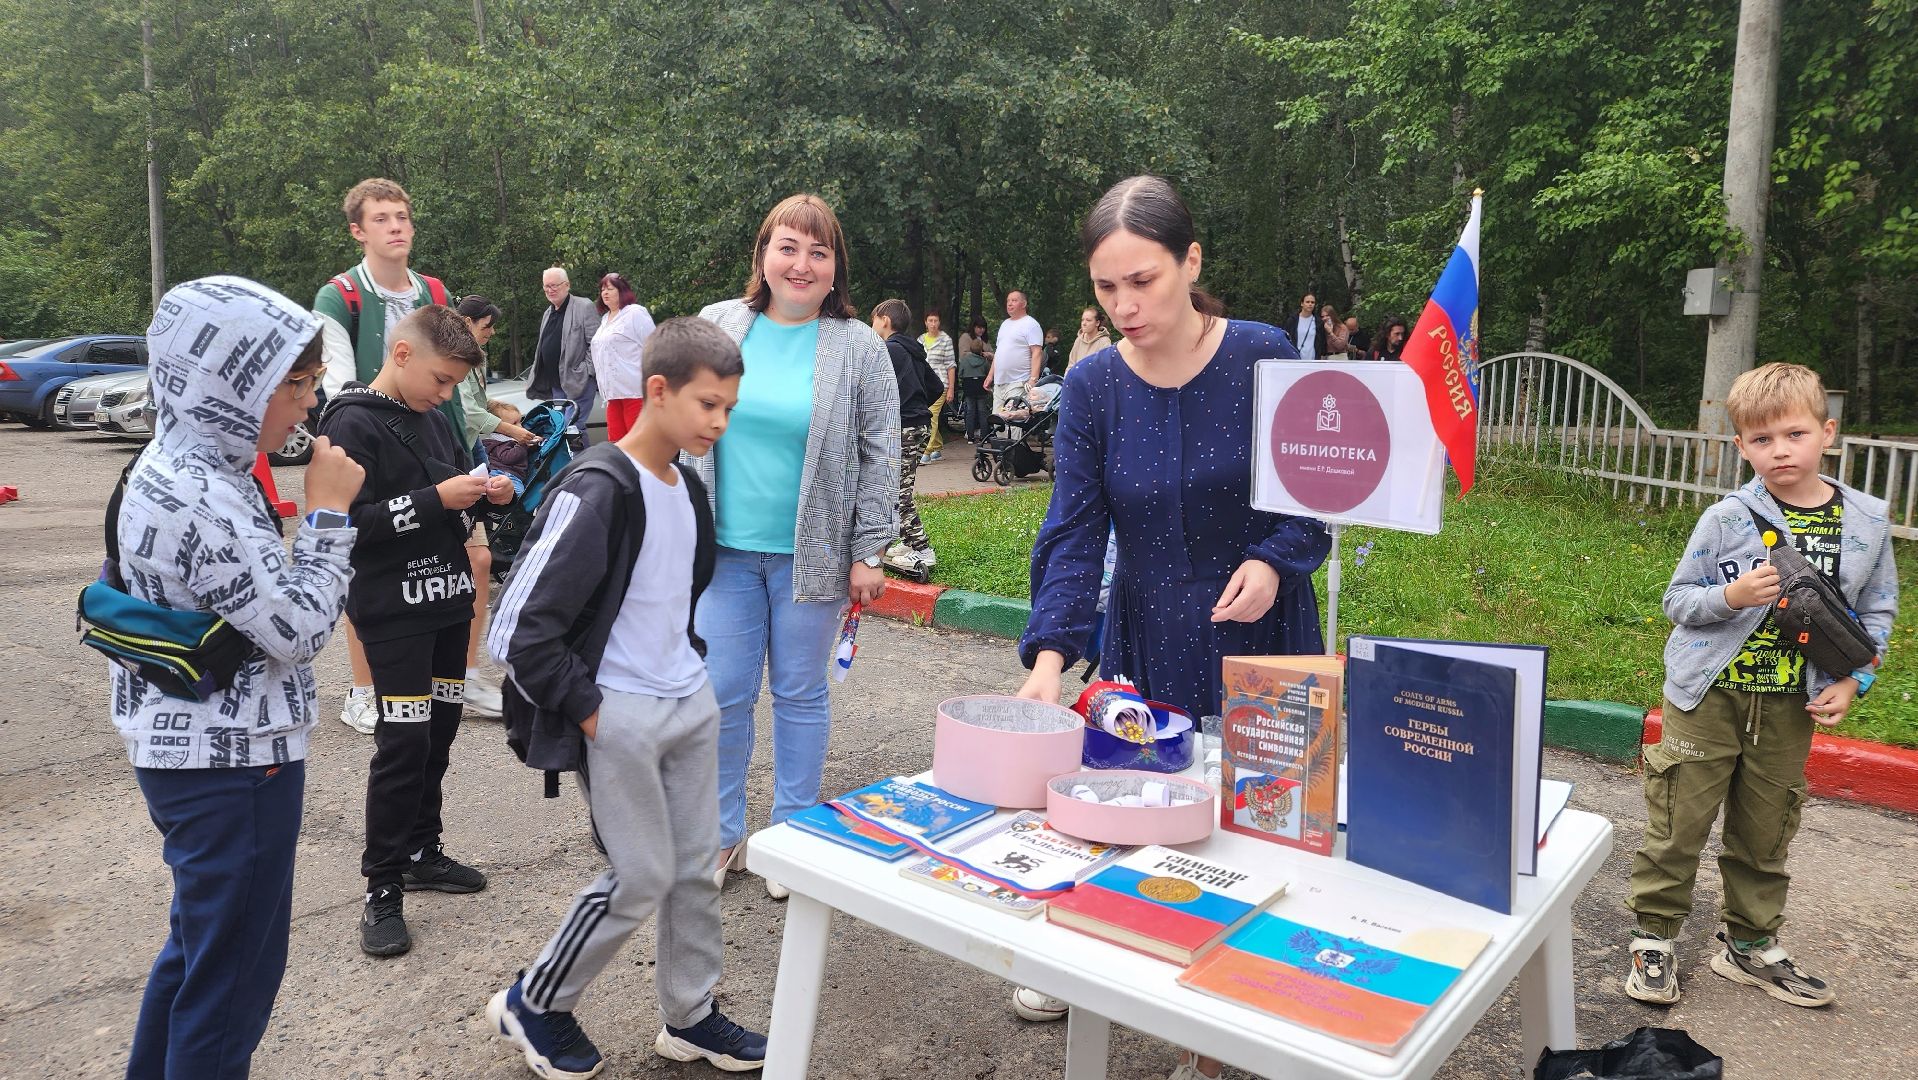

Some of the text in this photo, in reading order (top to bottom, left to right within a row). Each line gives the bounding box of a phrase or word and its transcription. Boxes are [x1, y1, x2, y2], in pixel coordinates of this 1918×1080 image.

[217, 335, 257, 382] TRAIL
[231, 327, 286, 401] RACE
[1428, 325, 1473, 421] РОССИЯ
[375, 390, 385, 399] IN
[184, 406, 258, 445] RAC
[1281, 442, 1377, 462] БИБЛИОТЕКА
[142, 464, 175, 490] TRAIL
[133, 475, 188, 513] RACE
[407, 555, 439, 569] BELIEVE
[407, 570, 417, 578] IN
[401, 571, 475, 605] URBA
[116, 668, 127, 717] TRAIL
[1400, 690, 1457, 707] COATS OF ARMS
[1393, 696, 1464, 717] OF MODERN RUSSIA
[1232, 724, 1304, 746] государственная
[1256, 715, 1305, 734] Российская
[1408, 718, 1449, 737] ГЕРБЫ
[1258, 741, 1304, 758] символика
[1384, 725, 1474, 755] СОВРЕМЕННОЙ
[1680, 740, 1695, 750] BOY
[1403, 741, 1453, 763] РОССИИ
[1680, 748, 1705, 758] WORLD
[886, 783, 935, 800] СИМВОЛЫ
[933, 797, 971, 812] РОССИИ
[1003, 830, 1098, 862] ГЕРАЛЬДИКИ
[1034, 833, 1083, 851] АЗБУКА
[1153, 861, 1237, 889] РОССИИ
